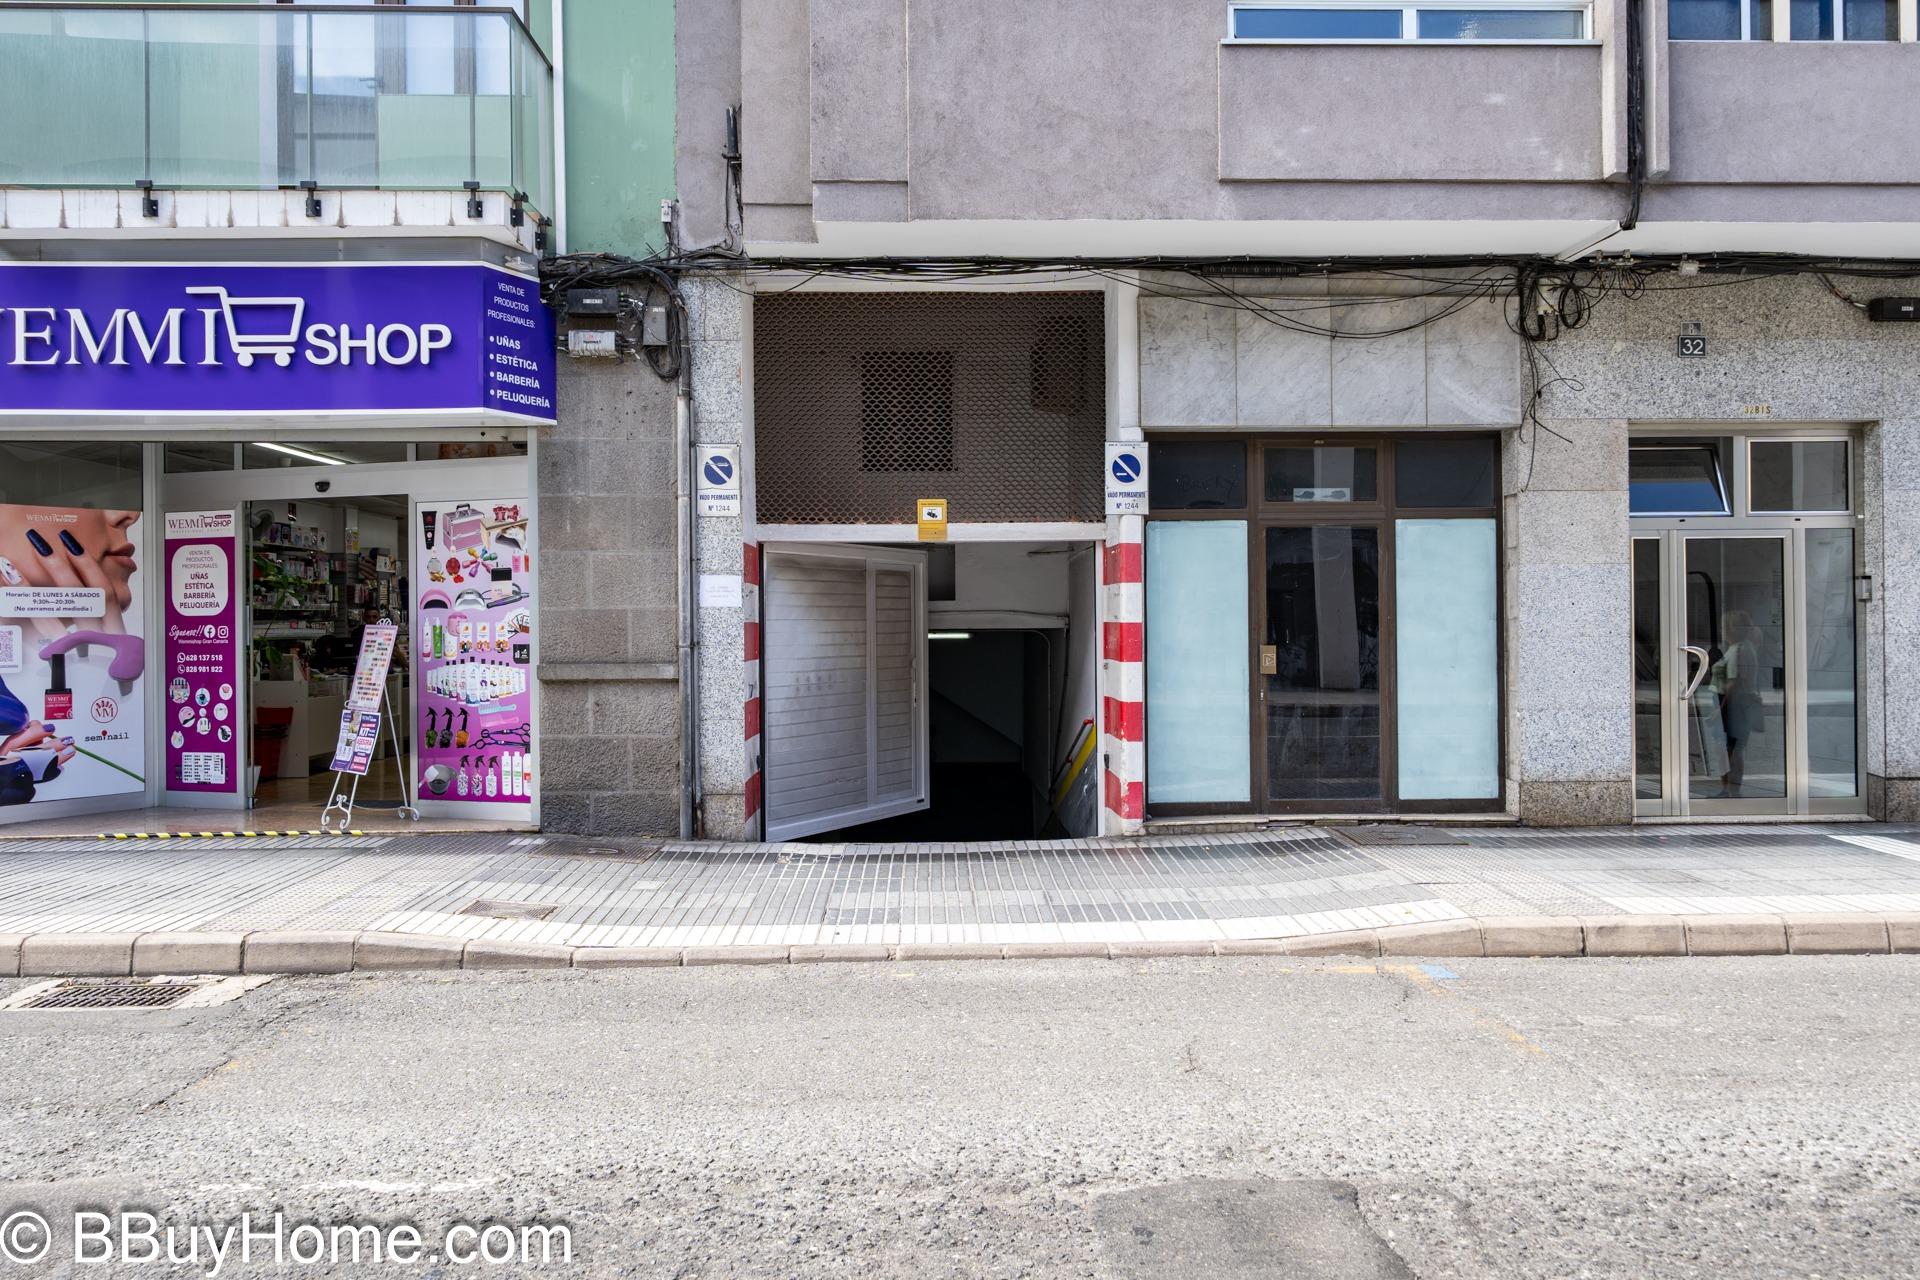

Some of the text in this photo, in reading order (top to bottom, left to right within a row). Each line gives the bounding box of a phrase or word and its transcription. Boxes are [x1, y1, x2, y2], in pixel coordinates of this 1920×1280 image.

[498, 282, 525, 297] VENTA DE
[494, 296, 529, 312] PRODUCTOS
[487, 309, 536, 328] PROFESIONALES:
[0, 308, 453, 366] EMMI SHOP
[496, 335, 521, 350] UÑAS
[1682, 339, 1704, 354] 32
[496, 353, 538, 371] ESTÉTICA
[496, 371, 540, 389] BARBERÍA
[496, 389, 551, 408] PELUQUERÍA
[168, 518, 231, 529] WEMMI SHOP
[190, 572, 208, 580] UÑAS
[185, 581, 214, 589] ESTÉTICA
[183, 591, 215, 599] BARBERÍA
[180, 601, 220, 609] PELUQUERÍA
[84, 730, 129, 742] seminail
